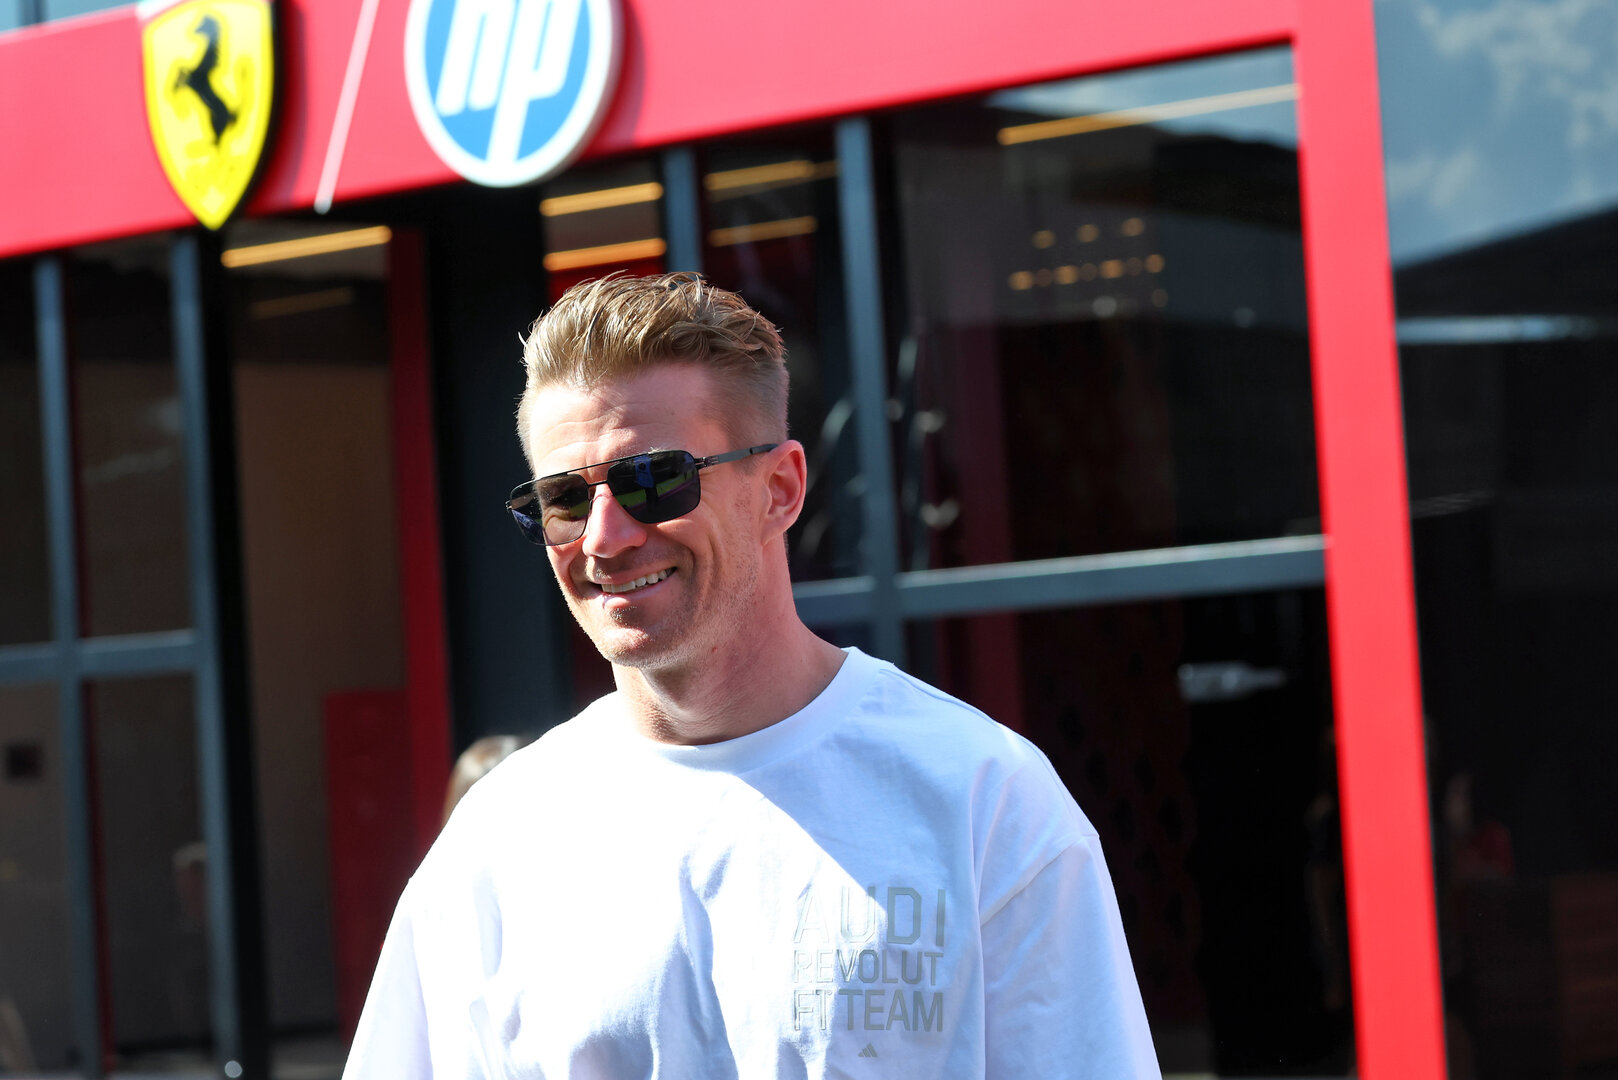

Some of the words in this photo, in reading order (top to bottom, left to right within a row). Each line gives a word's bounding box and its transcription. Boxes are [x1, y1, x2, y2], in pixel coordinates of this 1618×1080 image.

[793, 886, 946, 947] AUDI
[793, 949, 944, 986] REVOLUT
[838, 989, 944, 1032] TEAM
